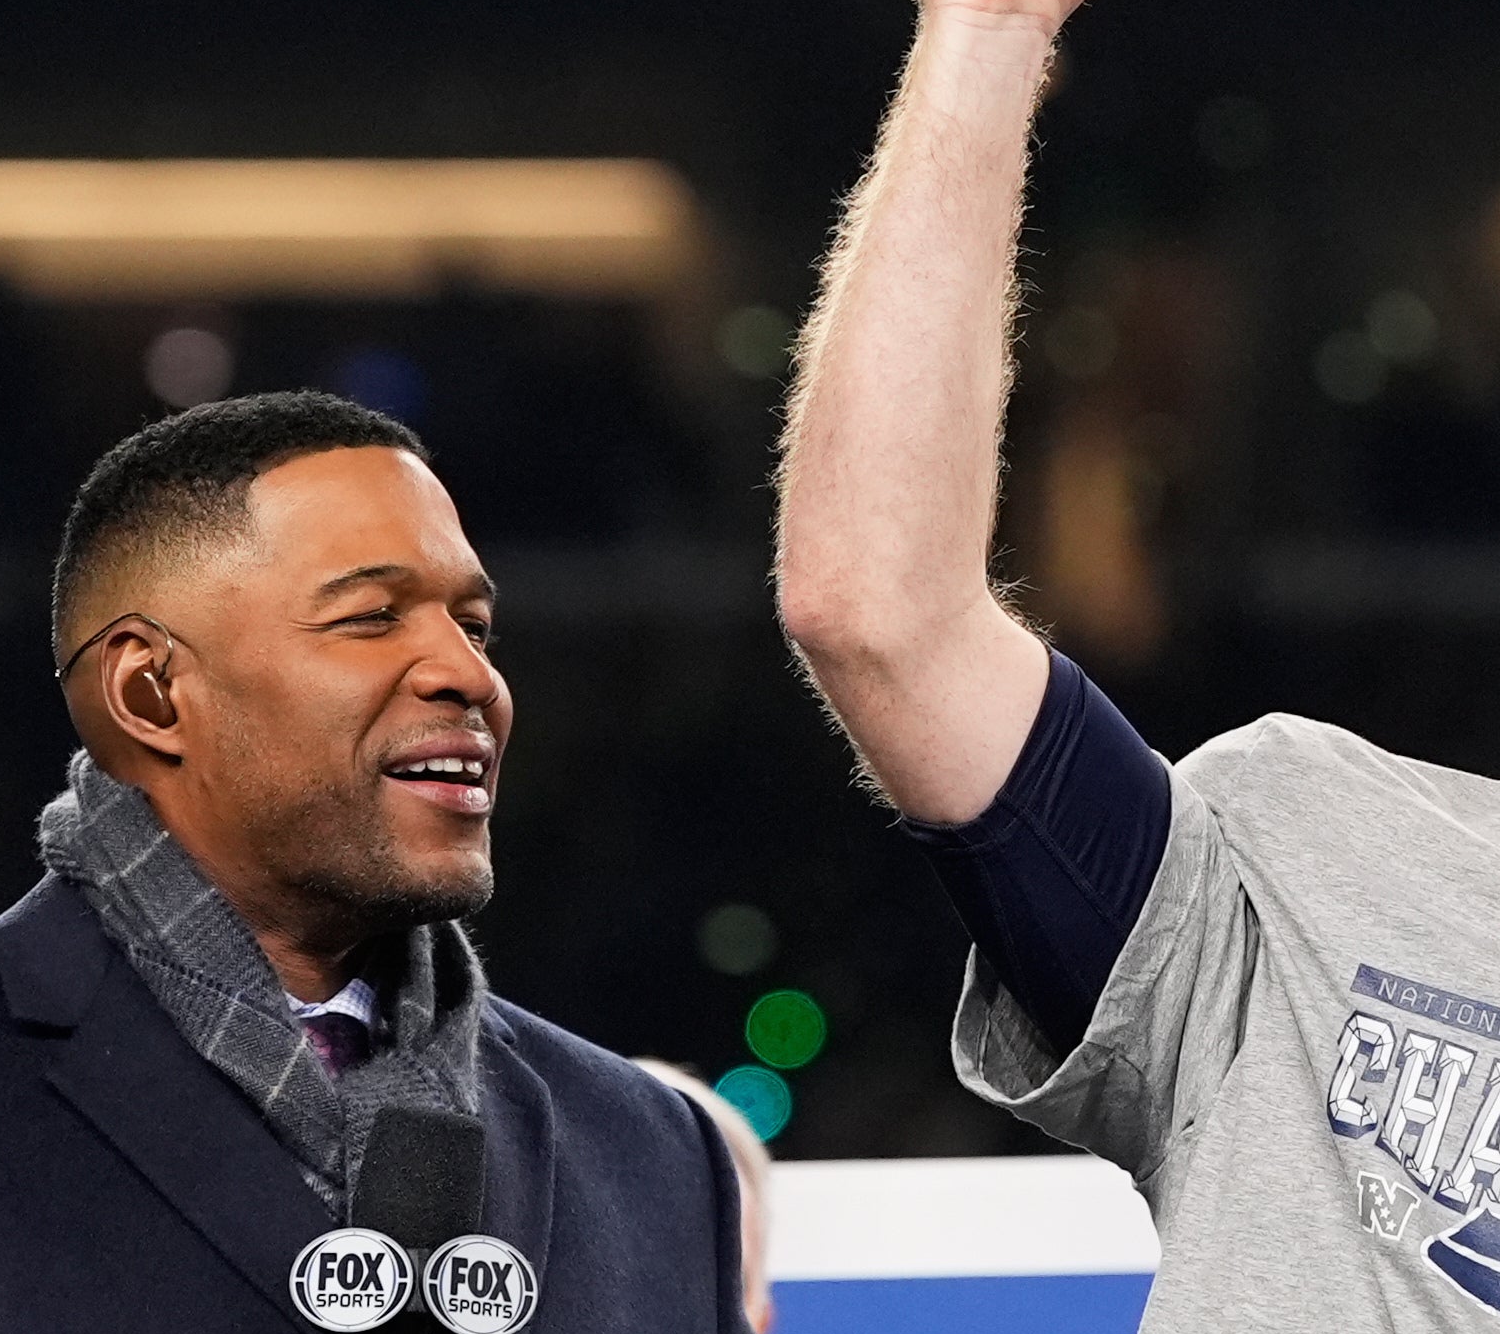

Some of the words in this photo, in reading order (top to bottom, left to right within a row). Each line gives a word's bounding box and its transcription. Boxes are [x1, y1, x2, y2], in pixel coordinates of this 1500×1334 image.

[318, 1252, 385, 1291] FOX
[450, 1256, 513, 1302] FOX
[316, 1293, 385, 1308] SPORTS
[449, 1298, 513, 1319] SPORTS
